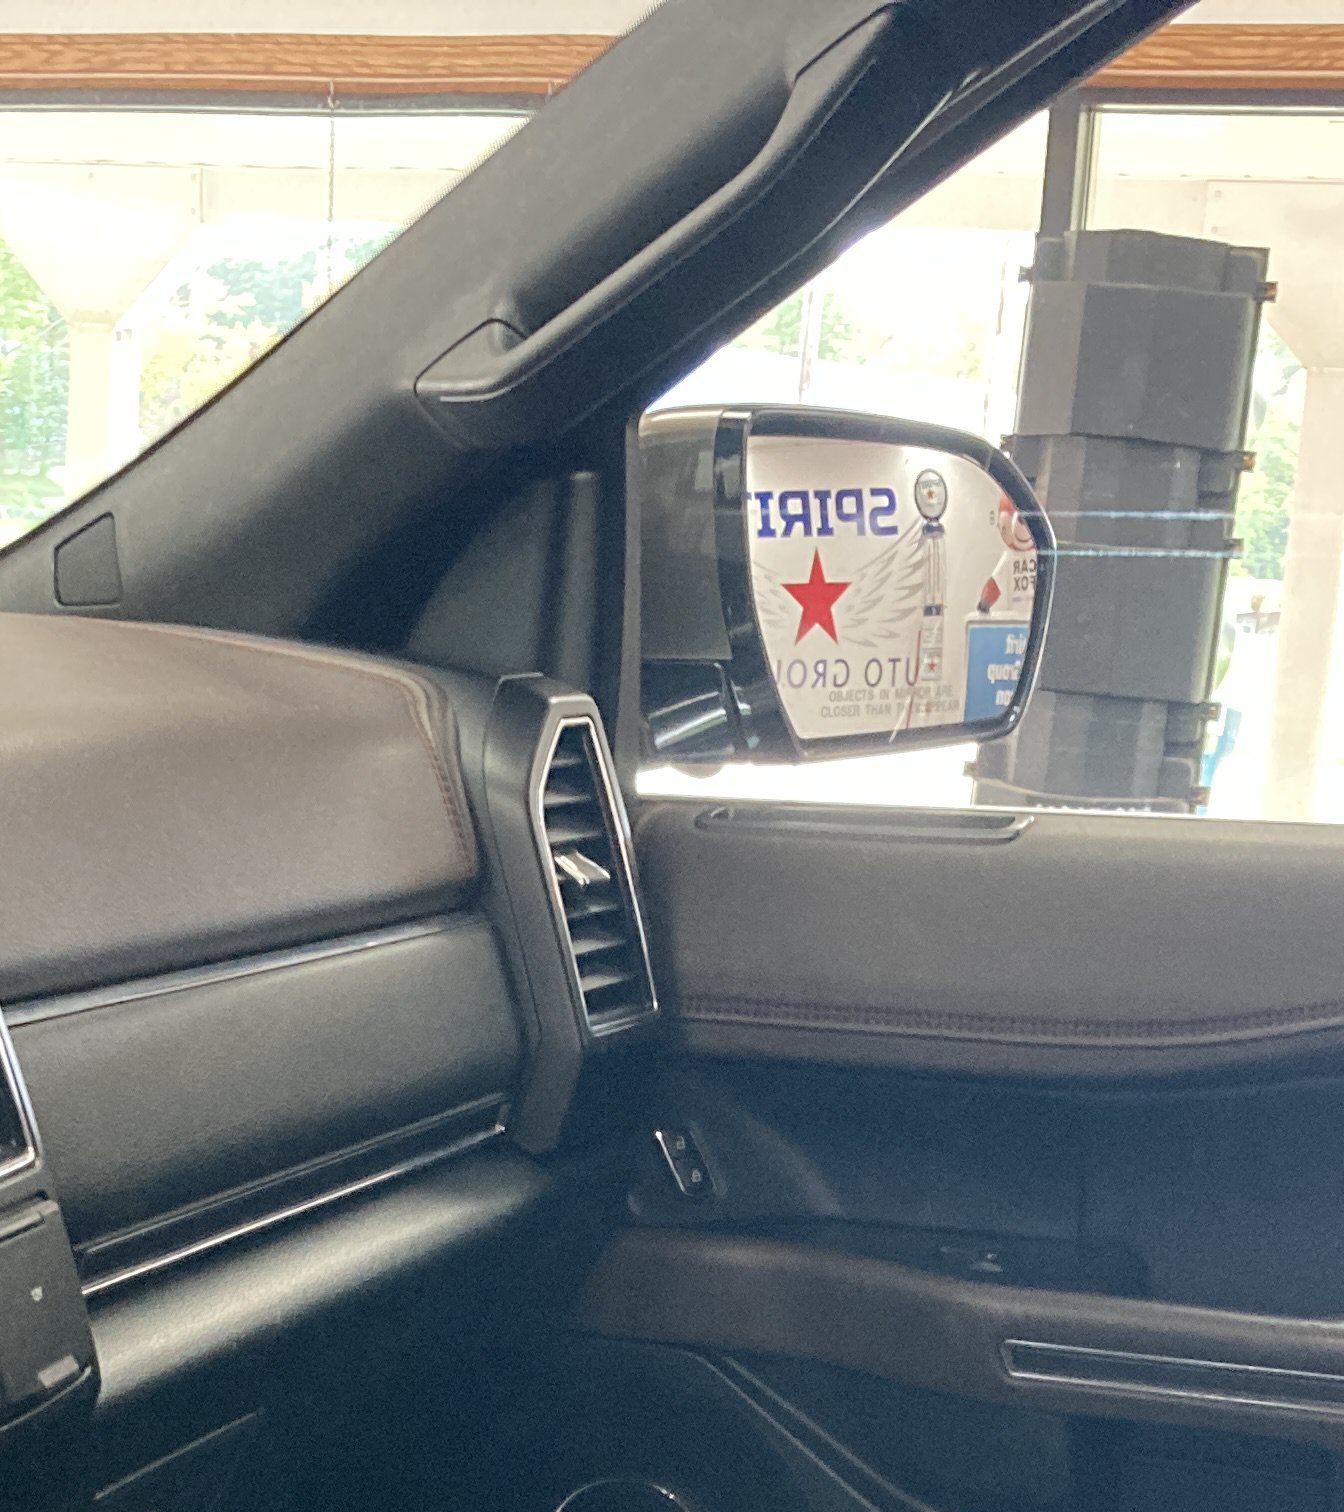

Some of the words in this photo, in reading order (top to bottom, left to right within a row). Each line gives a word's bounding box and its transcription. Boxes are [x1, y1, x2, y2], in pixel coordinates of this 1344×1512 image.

[829, 689, 874, 702] OBJECTS
[880, 688, 890, 700] IN
[821, 704, 860, 718] CLOSER
[866, 703, 891, 715] THAN
